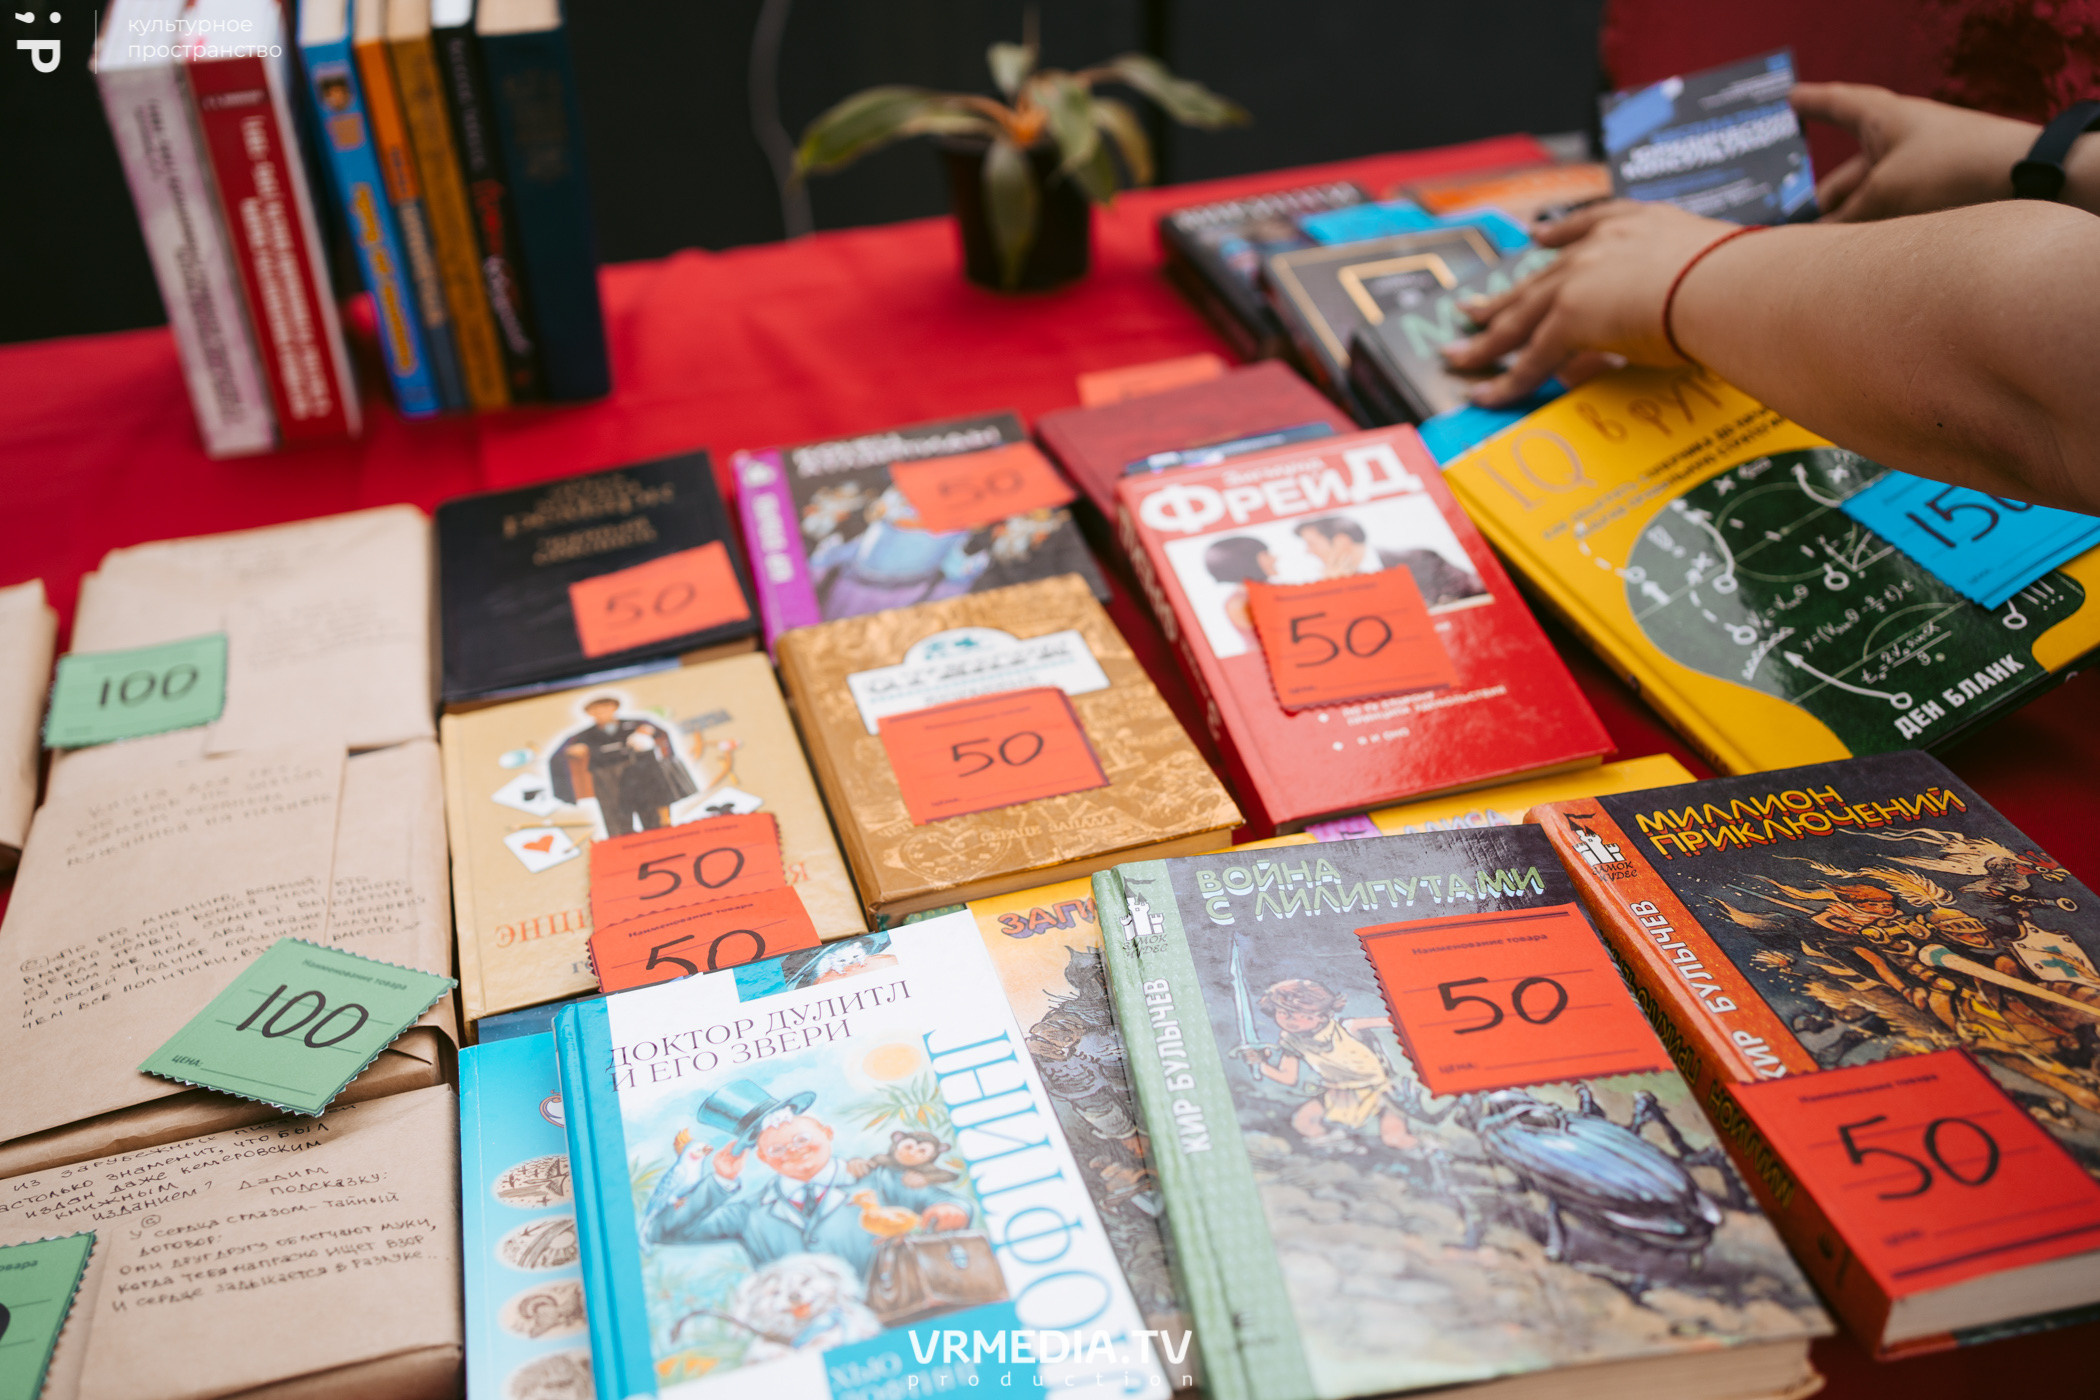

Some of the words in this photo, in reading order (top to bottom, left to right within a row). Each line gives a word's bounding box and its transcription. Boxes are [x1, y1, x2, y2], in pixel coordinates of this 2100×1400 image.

[1476, 428, 1598, 512] IQ
[1905, 485, 2033, 548] 15
[604, 581, 697, 629] 50
[1290, 611, 1392, 668] 50
[97, 663, 199, 711] 100
[1894, 699, 1946, 740] ДЕН
[1942, 653, 2026, 708] БЛАНК
[950, 731, 1044, 778] 50
[1635, 784, 1847, 836] МИЛЛИОН
[1649, 787, 1968, 861] ПРИКЛЮЧЕНИЙ
[638, 846, 745, 900] 50
[1195, 858, 1341, 898] ВОЙНА
[1205, 896, 1236, 926] С
[1255, 866, 1546, 922] ЛИЛИПУТАМИ
[629, 911, 713, 938] Наименование
[716, 902, 754, 915] товара
[997, 897, 1096, 939] ЗАП
[1411, 937, 1504, 955] Наименование
[1506, 933, 1548, 946] товара
[645, 929, 766, 976] 50
[1630, 900, 1739, 1014] БУЛЫЧЕВ
[236, 984, 369, 1048] 100
[606, 1018, 755, 1074] ДОКТОР
[765, 980, 912, 1035] ДУЛИТЛ
[1438, 976, 1568, 1034] 50
[612, 1068, 636, 1093] И
[650, 1051, 720, 1083] ЕГО
[731, 1019, 852, 1064] ЗВЕРИ
[1143, 977, 1196, 1092] БУЛЫЧЕВ
[1732, 1030, 1788, 1079] КИР
[1172, 1097, 1213, 1155] КИР
[1838, 1115, 2000, 1201] 50
[0, 1179, 94, 1213] астолько
